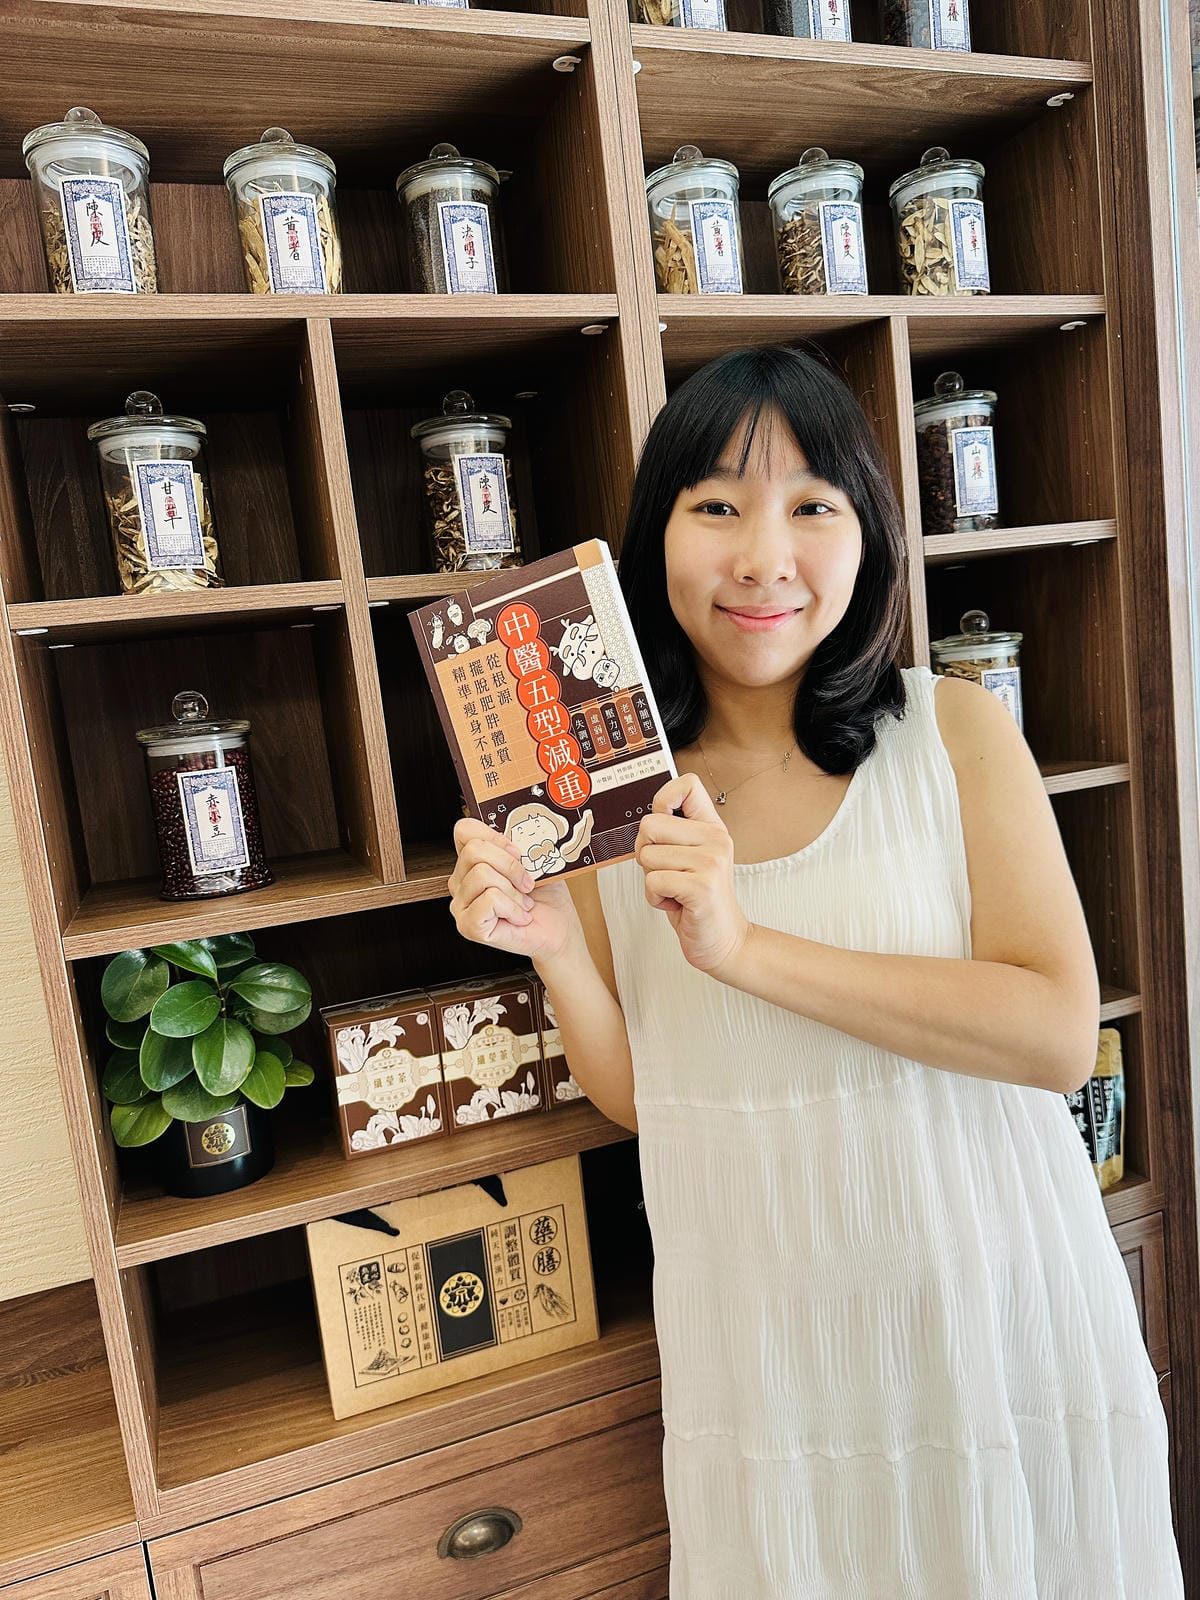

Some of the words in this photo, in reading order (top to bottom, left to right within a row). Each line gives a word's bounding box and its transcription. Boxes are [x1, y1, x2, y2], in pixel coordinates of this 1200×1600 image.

[86, 199, 110, 247] 陳皮
[485, 653, 513, 706] 從根源
[503, 611, 587, 805] 中醫五型減重
[452, 666, 500, 789] 精準瘦身不復胖
[469, 659, 512, 765] 擺脫肥胖體質
[206, 793, 227, 839] 赤小豆
[504, 1223, 521, 1282] 調整體質
[533, 1216, 559, 1273] 藥膳
